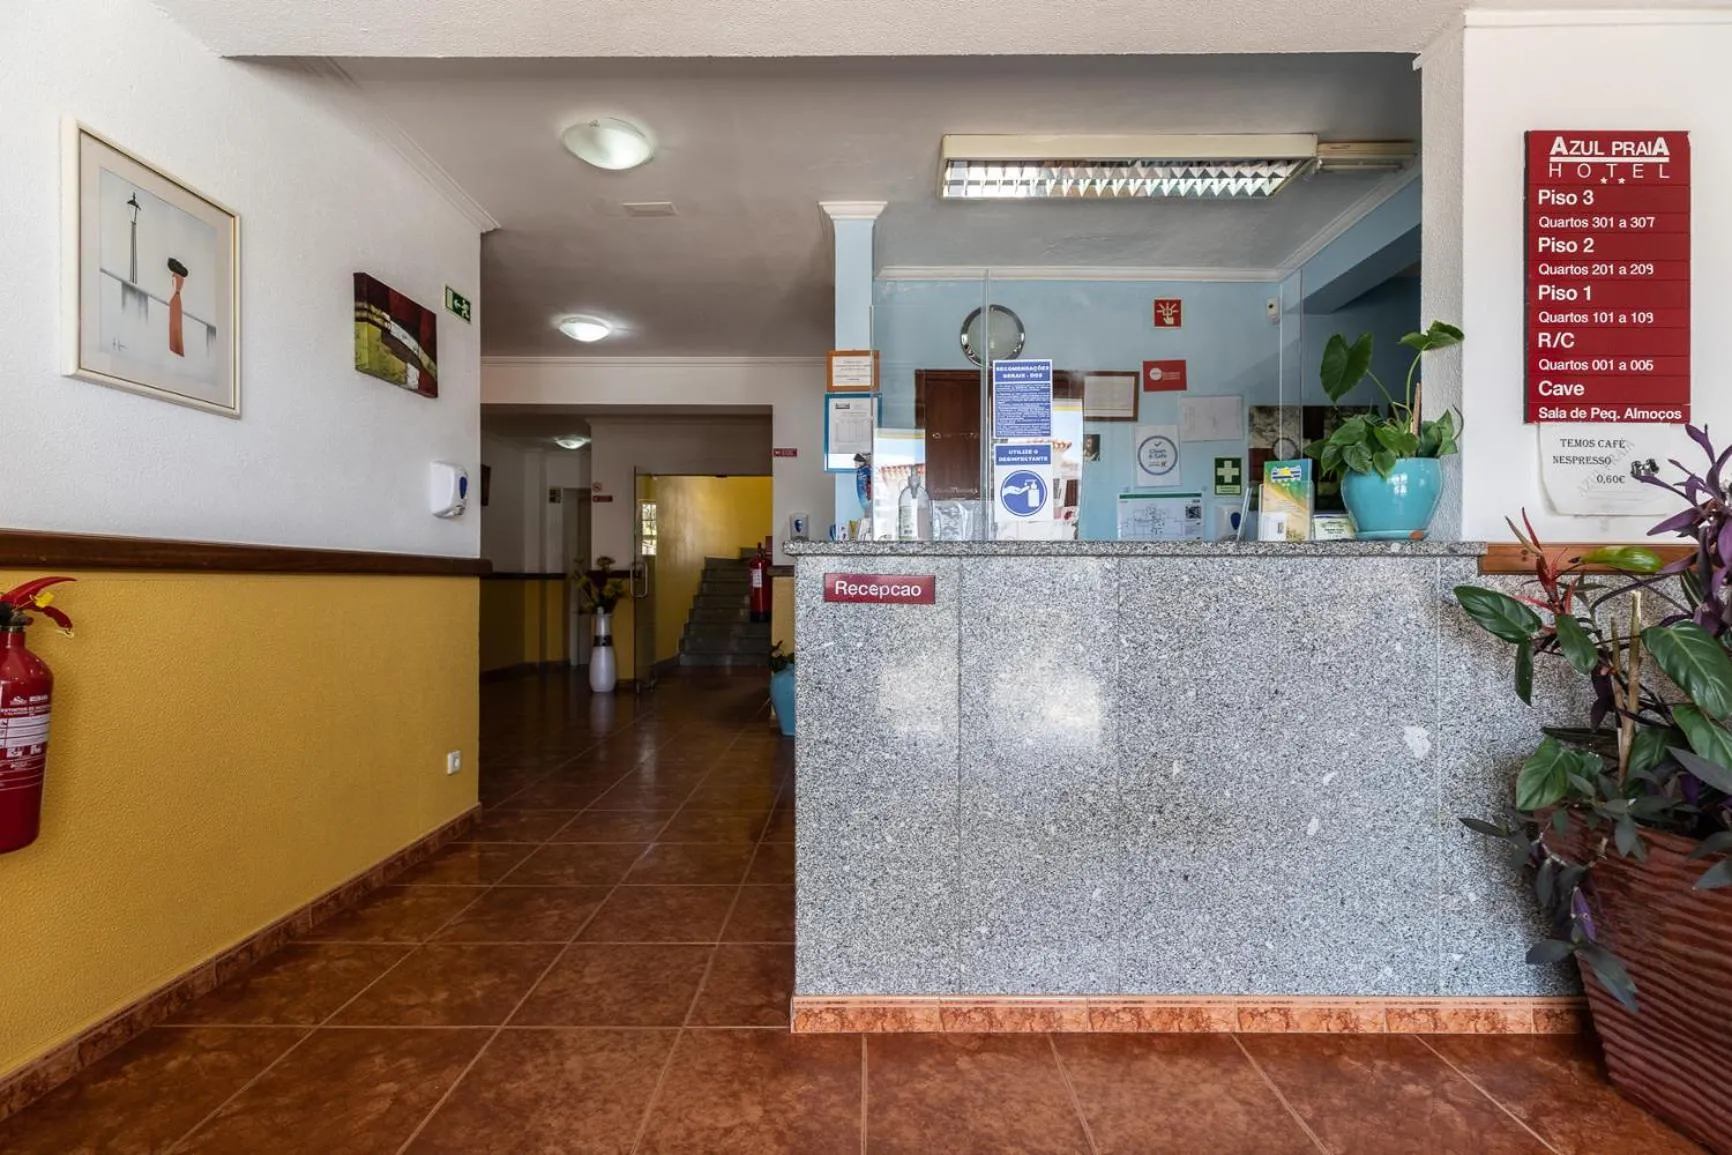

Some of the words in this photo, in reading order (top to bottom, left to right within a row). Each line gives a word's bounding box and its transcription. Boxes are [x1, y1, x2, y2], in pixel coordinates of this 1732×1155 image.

[1549, 136, 1605, 156] AZUL
[1611, 136, 1671, 156] PRAIA
[1548, 163, 1671, 179] HOTEL
[1538, 188, 1578, 206] Piso
[1582, 189, 1595, 206] 3
[1538, 215, 1589, 229] Quartos
[1591, 216, 1614, 229] 301
[1618, 218, 1628, 229] a
[1629, 216, 1656, 229] 307
[1538, 236, 1578, 253] Piso
[1582, 237, 1595, 253] 2
[1538, 263, 1589, 276] Quartos
[1591, 263, 1614, 276] 201
[1618, 265, 1628, 276] a
[1538, 284, 1578, 301] Piso
[1582, 285, 1592, 301] 1
[1538, 311, 1589, 324] Quartos
[1592, 311, 1614, 324] 101
[1618, 313, 1628, 324] a
[1538, 332, 1575, 349] R/C
[1538, 358, 1589, 371] Quartos
[1591, 359, 1614, 371] 001
[1618, 361, 1628, 371] a
[1538, 379, 1585, 397] Cave
[1538, 406, 1567, 419] Sala
[1569, 407, 1588, 419] de
[1590, 407, 1621, 421] Peq.
[1623, 407, 1683, 421] Almoços
[1560, 438, 1596, 449] TEMOS
[1552, 455, 1613, 466] NESPRESSO
[1596, 474, 1626, 485] 0,60€
[834, 580, 922, 600] Recepcao
